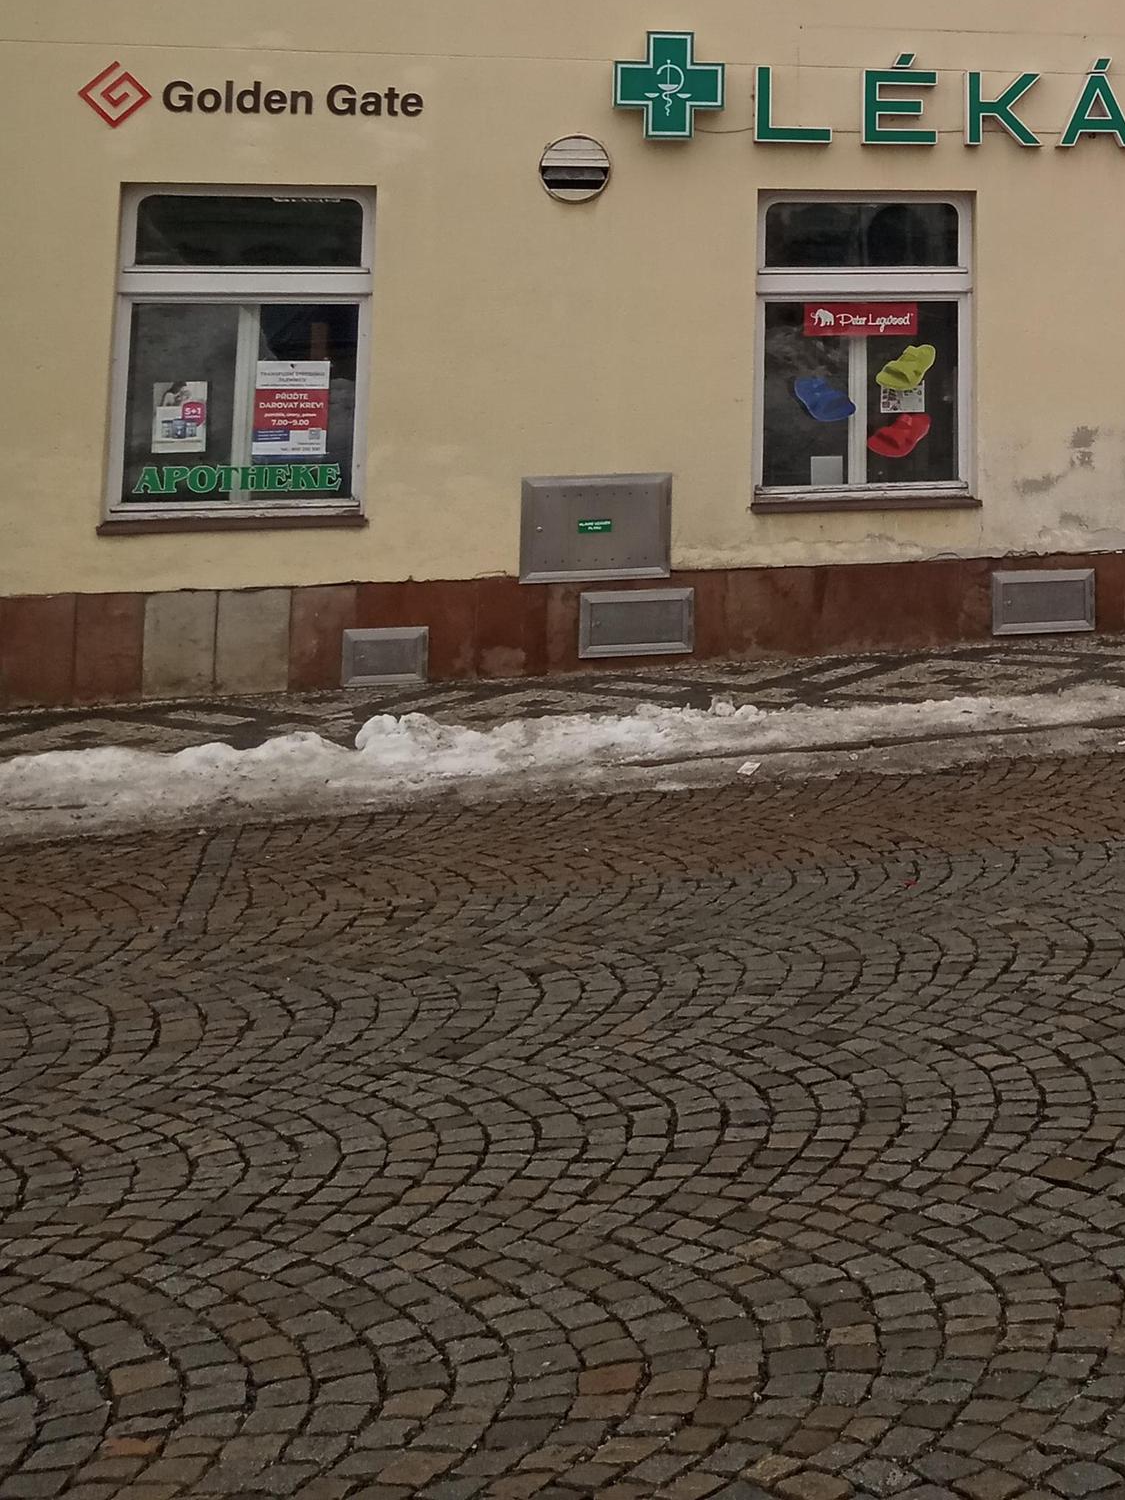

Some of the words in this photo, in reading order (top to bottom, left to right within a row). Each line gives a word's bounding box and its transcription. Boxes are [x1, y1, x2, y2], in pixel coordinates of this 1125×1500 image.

[162, 80, 313, 115] Golden
[326, 84, 424, 117] Gate
[132, 463, 343, 494] APOTHEKE
